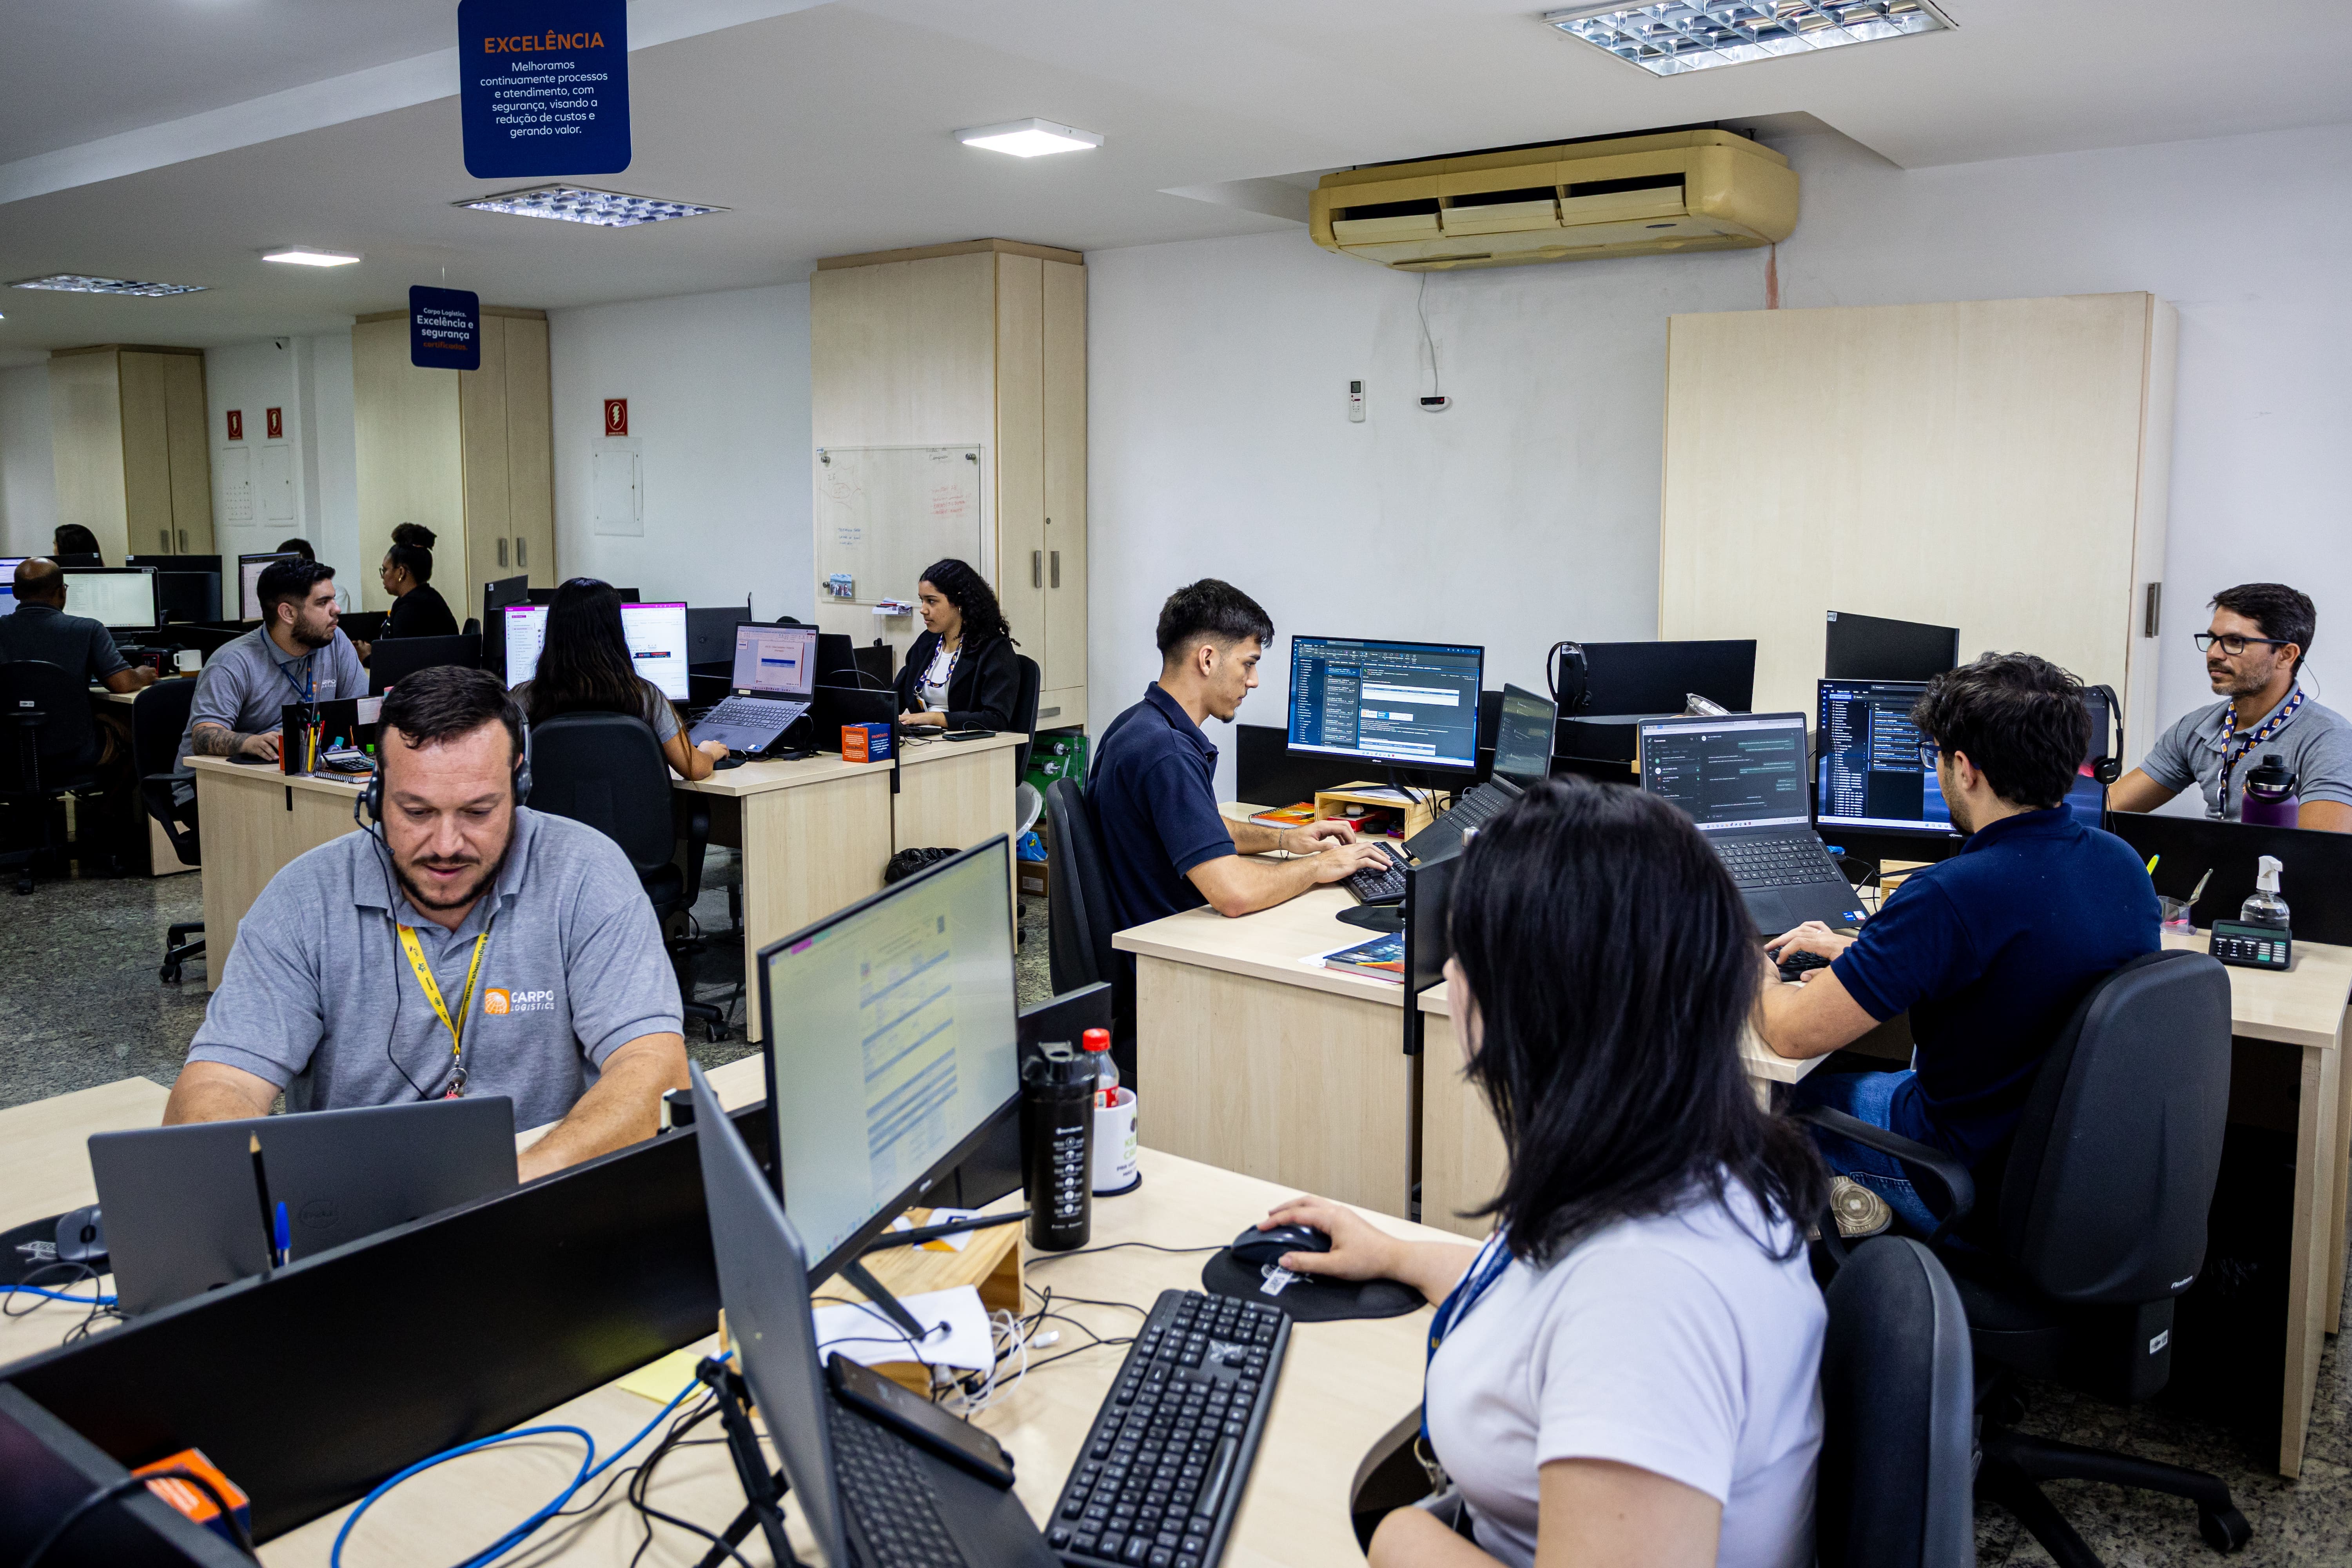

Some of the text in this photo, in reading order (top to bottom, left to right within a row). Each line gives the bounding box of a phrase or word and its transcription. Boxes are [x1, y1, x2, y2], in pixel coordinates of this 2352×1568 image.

[484, 30, 604, 53] EXCELÊNCIA
[512, 62, 575, 72] Melhoramos
[480, 72, 608, 86] continuamente processos
[503, 88, 570, 98] atendimento,
[492, 102, 547, 113] segurança,
[550, 99, 588, 109] visando
[496, 114, 537, 125] redução
[555, 112, 586, 121] custos
[510, 125, 582, 138] gerando valor.
[417, 315, 466, 328] Excelência
[422, 329, 469, 341] segurança
[472, 943, 486, 979] segurança
[511, 990, 554, 1003] CARPO
[511, 1002, 555, 1011] LOGISTICS
